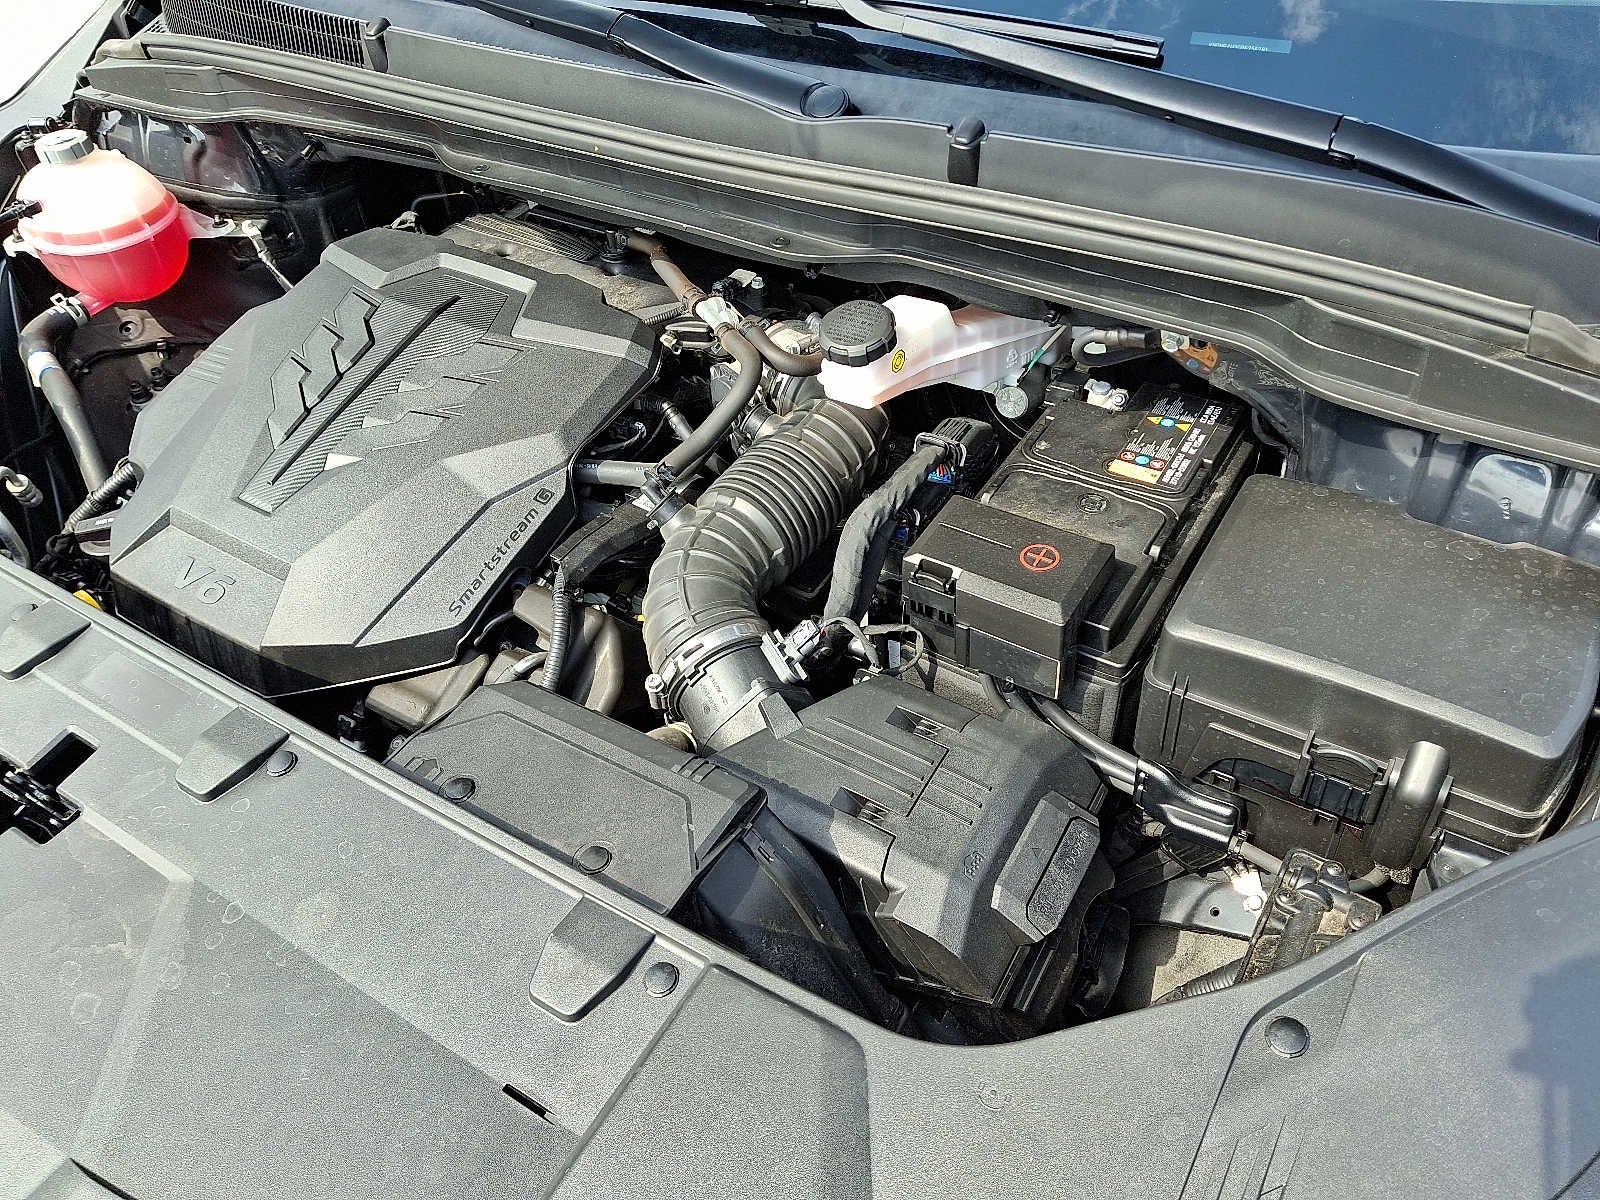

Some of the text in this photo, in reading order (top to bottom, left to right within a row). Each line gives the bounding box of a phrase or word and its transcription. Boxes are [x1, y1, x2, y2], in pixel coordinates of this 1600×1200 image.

[175, 554, 237, 605] V6
[448, 487, 555, 617] Smartstream G
